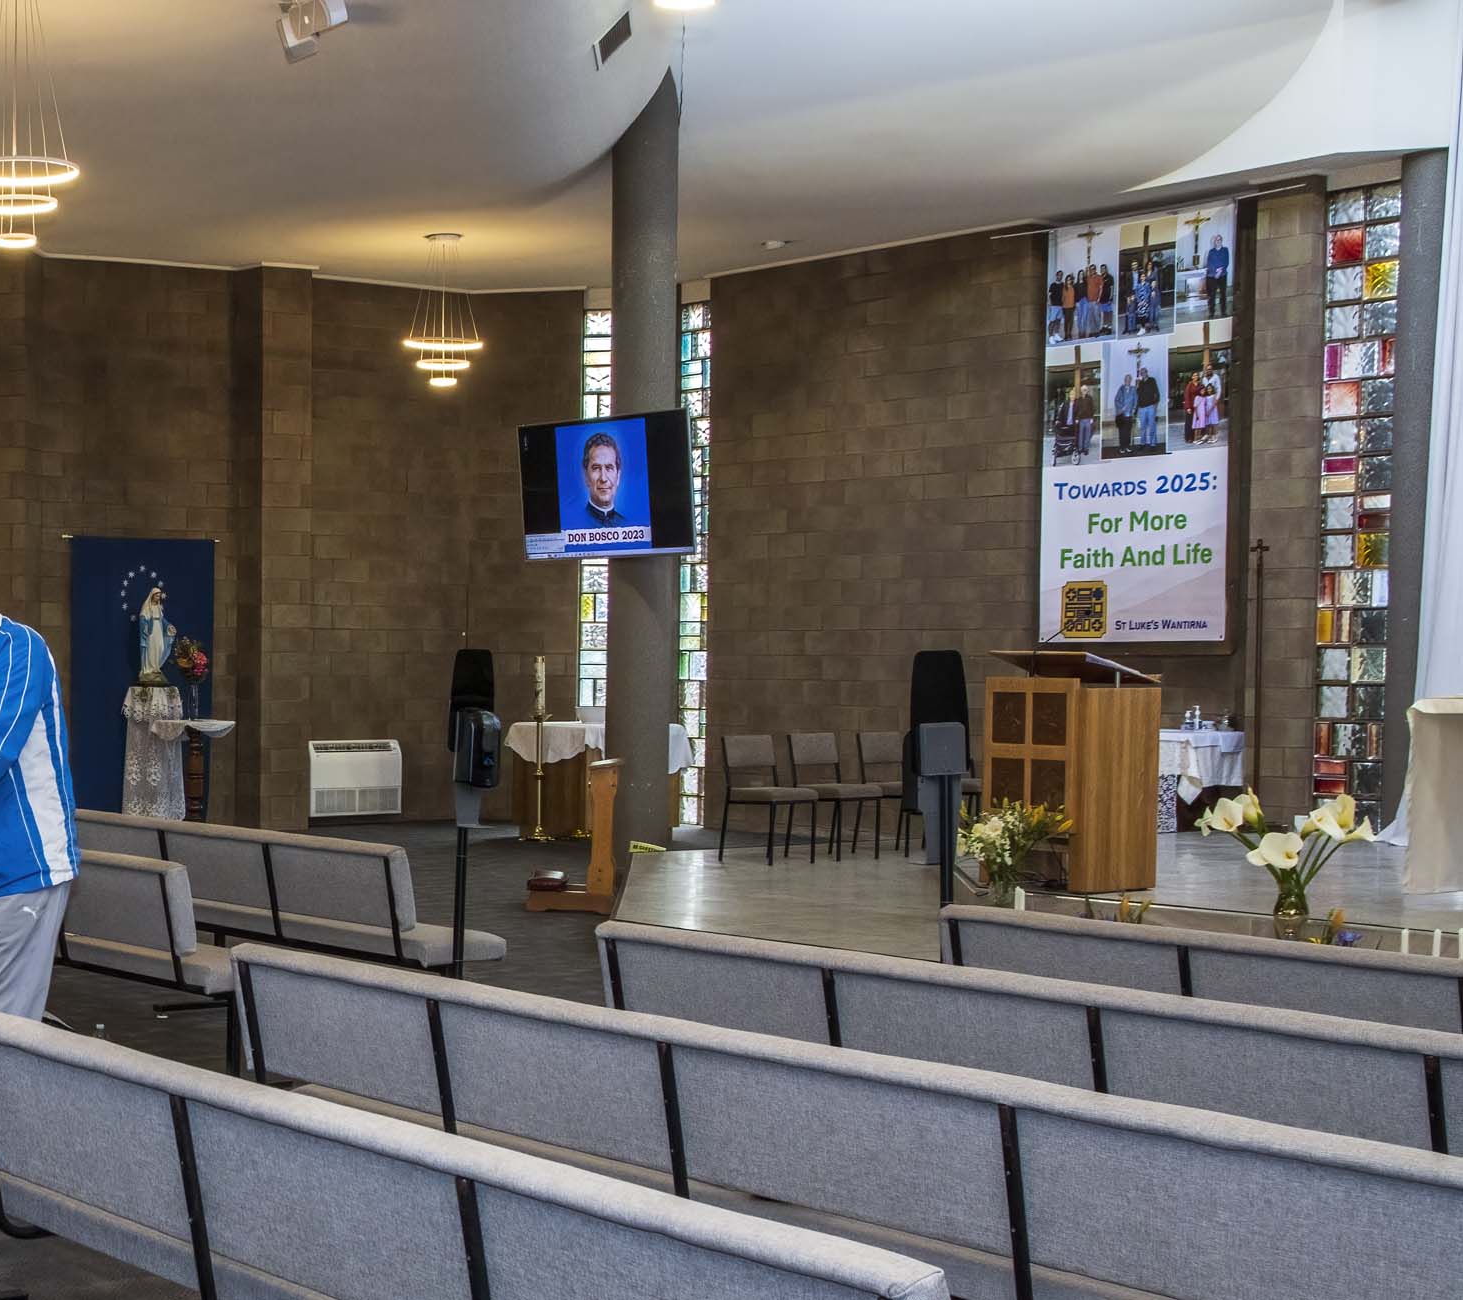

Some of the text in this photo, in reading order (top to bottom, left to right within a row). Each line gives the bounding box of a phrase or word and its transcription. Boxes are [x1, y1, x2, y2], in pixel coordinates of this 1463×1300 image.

[1155, 472, 1217, 494] 2025:
[1088, 510, 1187, 534] For More
[568, 529, 645, 542] DON BOSCO 2023
[1060, 543, 1213, 569] Faith And Life
